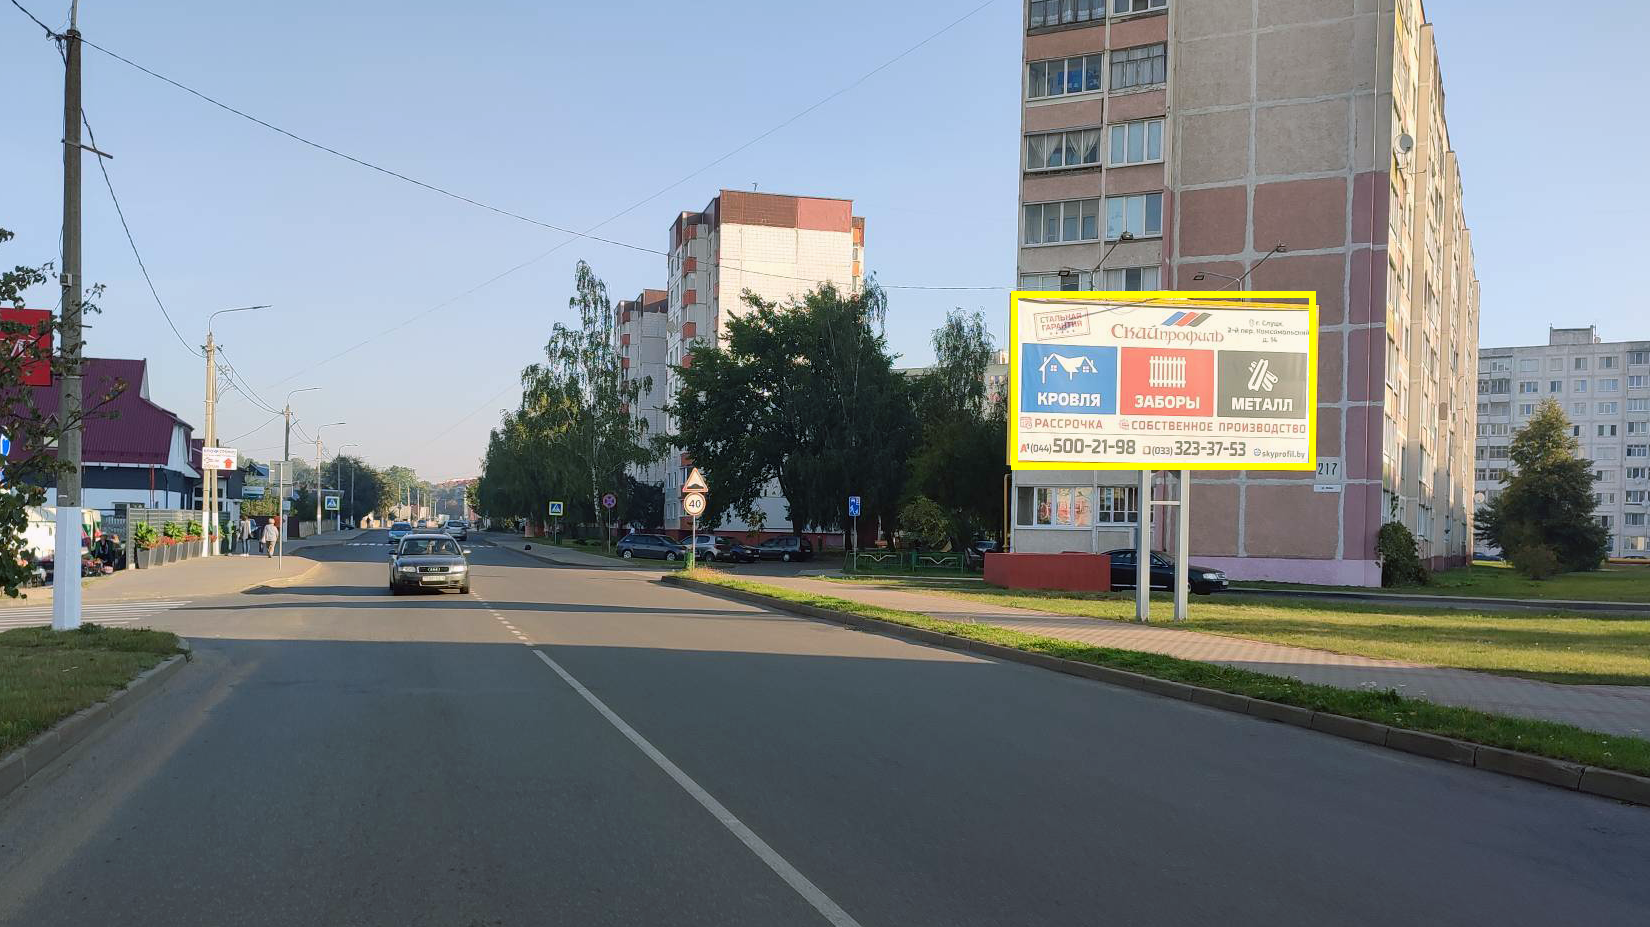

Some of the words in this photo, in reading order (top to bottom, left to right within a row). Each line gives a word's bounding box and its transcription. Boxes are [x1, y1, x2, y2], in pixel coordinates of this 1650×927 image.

[1111, 323, 1224, 346] Скайпрофиль
[1037, 391, 1101, 407] КРОВЛЯ
[1134, 394, 1200, 410] ЗАБОРЫ
[1231, 397, 1293, 412] МЕТАЛЛ
[1034, 418, 1103, 430] РАССРОЧКА
[1131, 419, 1213, 432] СОБСТВЕННОЕ
[1218, 421, 1306, 434] ПРОИЗВОДСТВО
[1262, 450, 1306, 459] skyprofil.by
[1318, 462, 1338, 476] 217
[688, 499, 701, 509] 40
